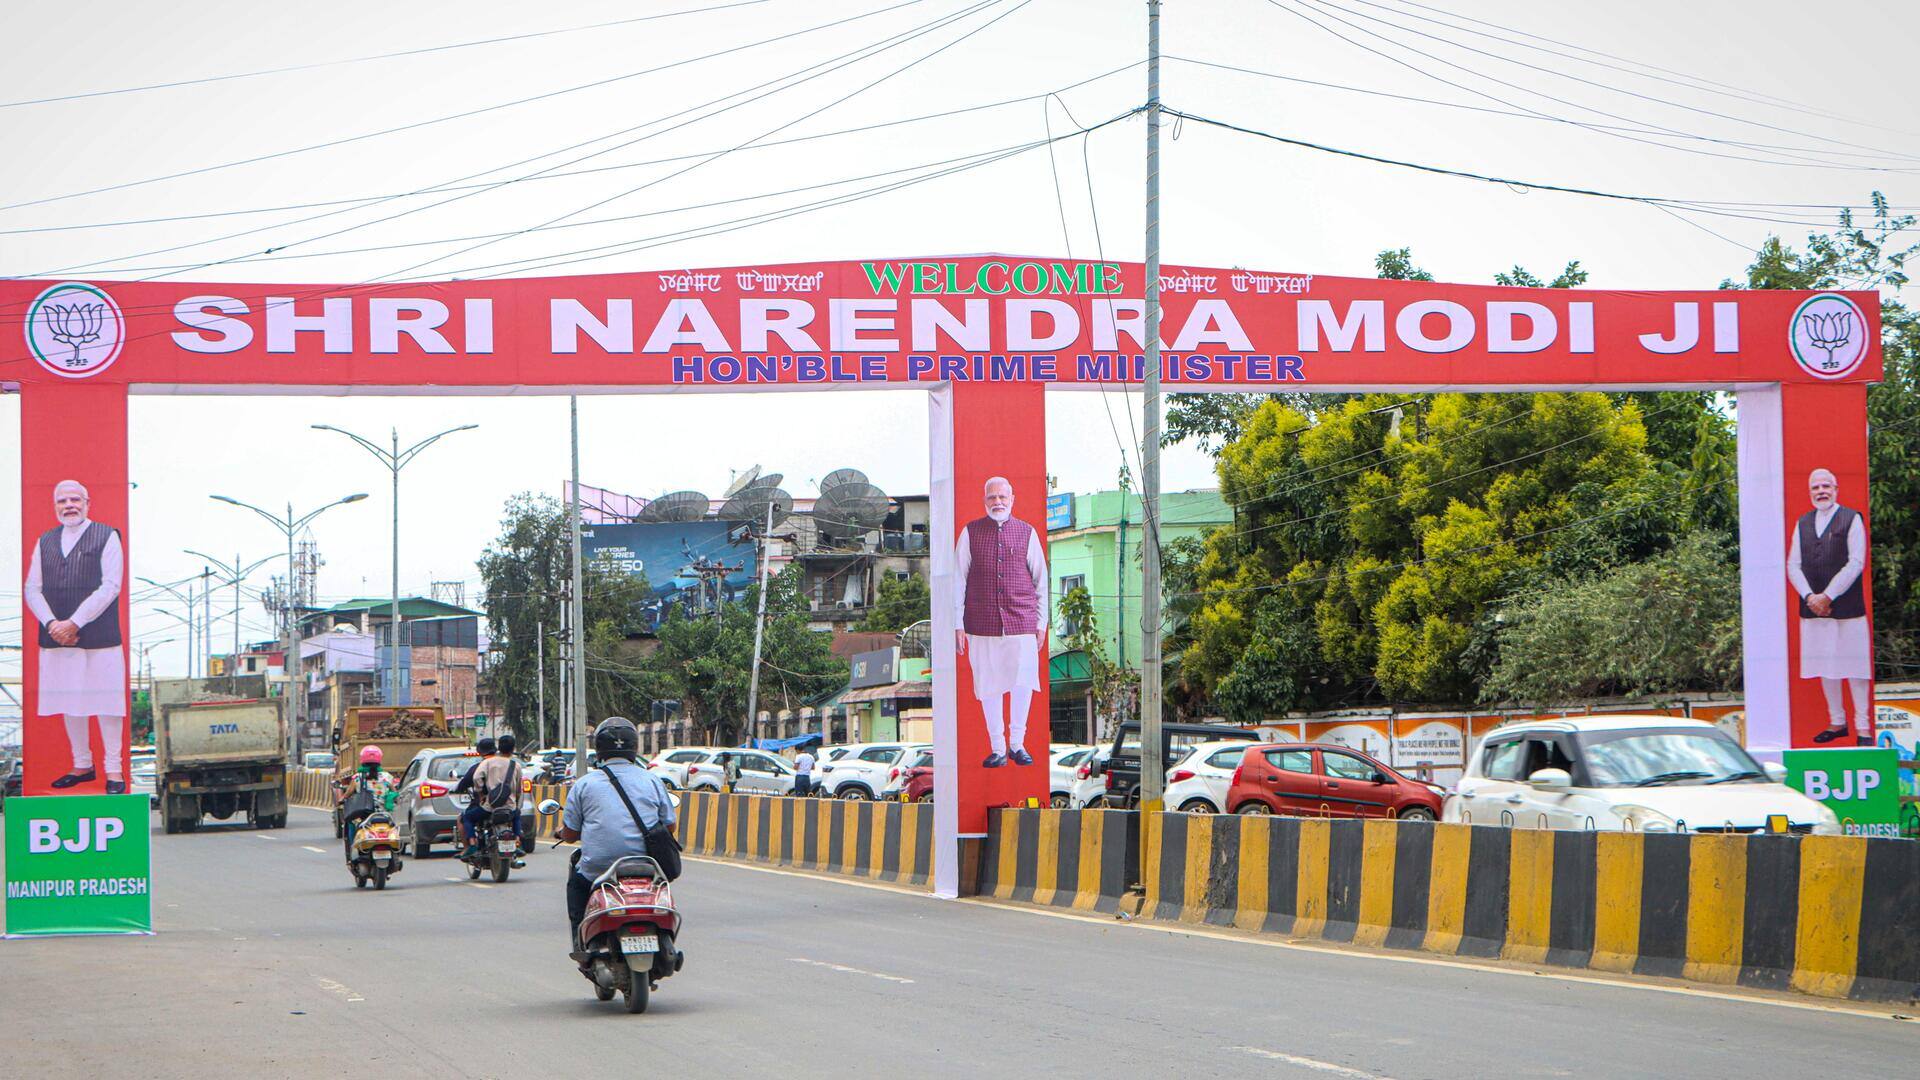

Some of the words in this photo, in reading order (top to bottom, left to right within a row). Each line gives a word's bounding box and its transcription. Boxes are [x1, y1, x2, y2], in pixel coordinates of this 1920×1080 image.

[861, 261, 1124, 295] WELCOME
[170, 295, 494, 354] SHRI
[551, 298, 1256, 353] NARENDRA
[1297, 300, 1594, 354] MODI
[1638, 302, 1740, 354] JI
[673, 355, 888, 382] HON'BLE
[907, 355, 1058, 382] PRIME
[1076, 355, 1306, 381] MINISTER
[209, 723, 239, 735] TATA
[1804, 769, 1881, 801] BJP
[29, 817, 125, 854] BJP
[1845, 823, 1900, 837] PRADESH
[8, 880, 76, 898] MANIPUR
[80, 877, 147, 896] PRADESH
